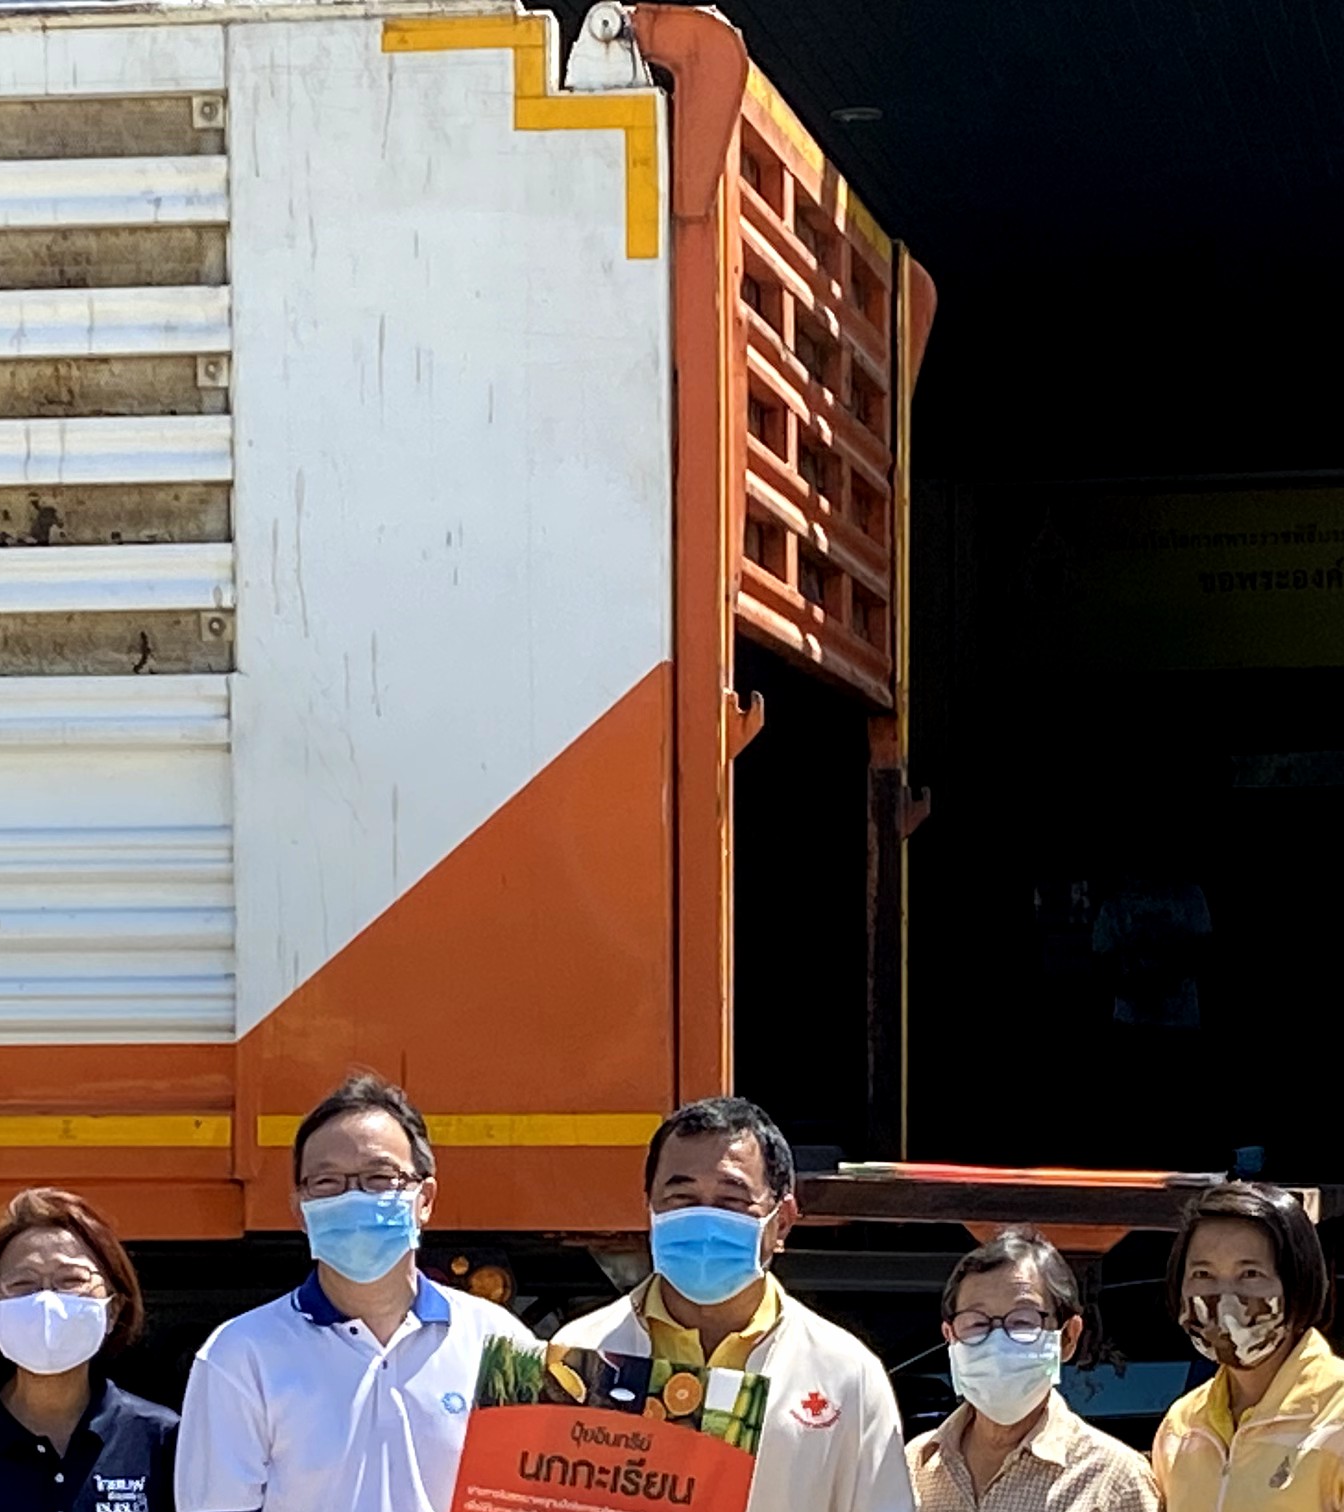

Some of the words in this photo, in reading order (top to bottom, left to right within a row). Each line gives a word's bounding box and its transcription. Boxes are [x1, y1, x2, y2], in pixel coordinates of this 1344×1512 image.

[571, 1420, 654, 1453] ปุ๋ยอินทรีย์
[519, 1450, 696, 1506] นกกะเรียน
